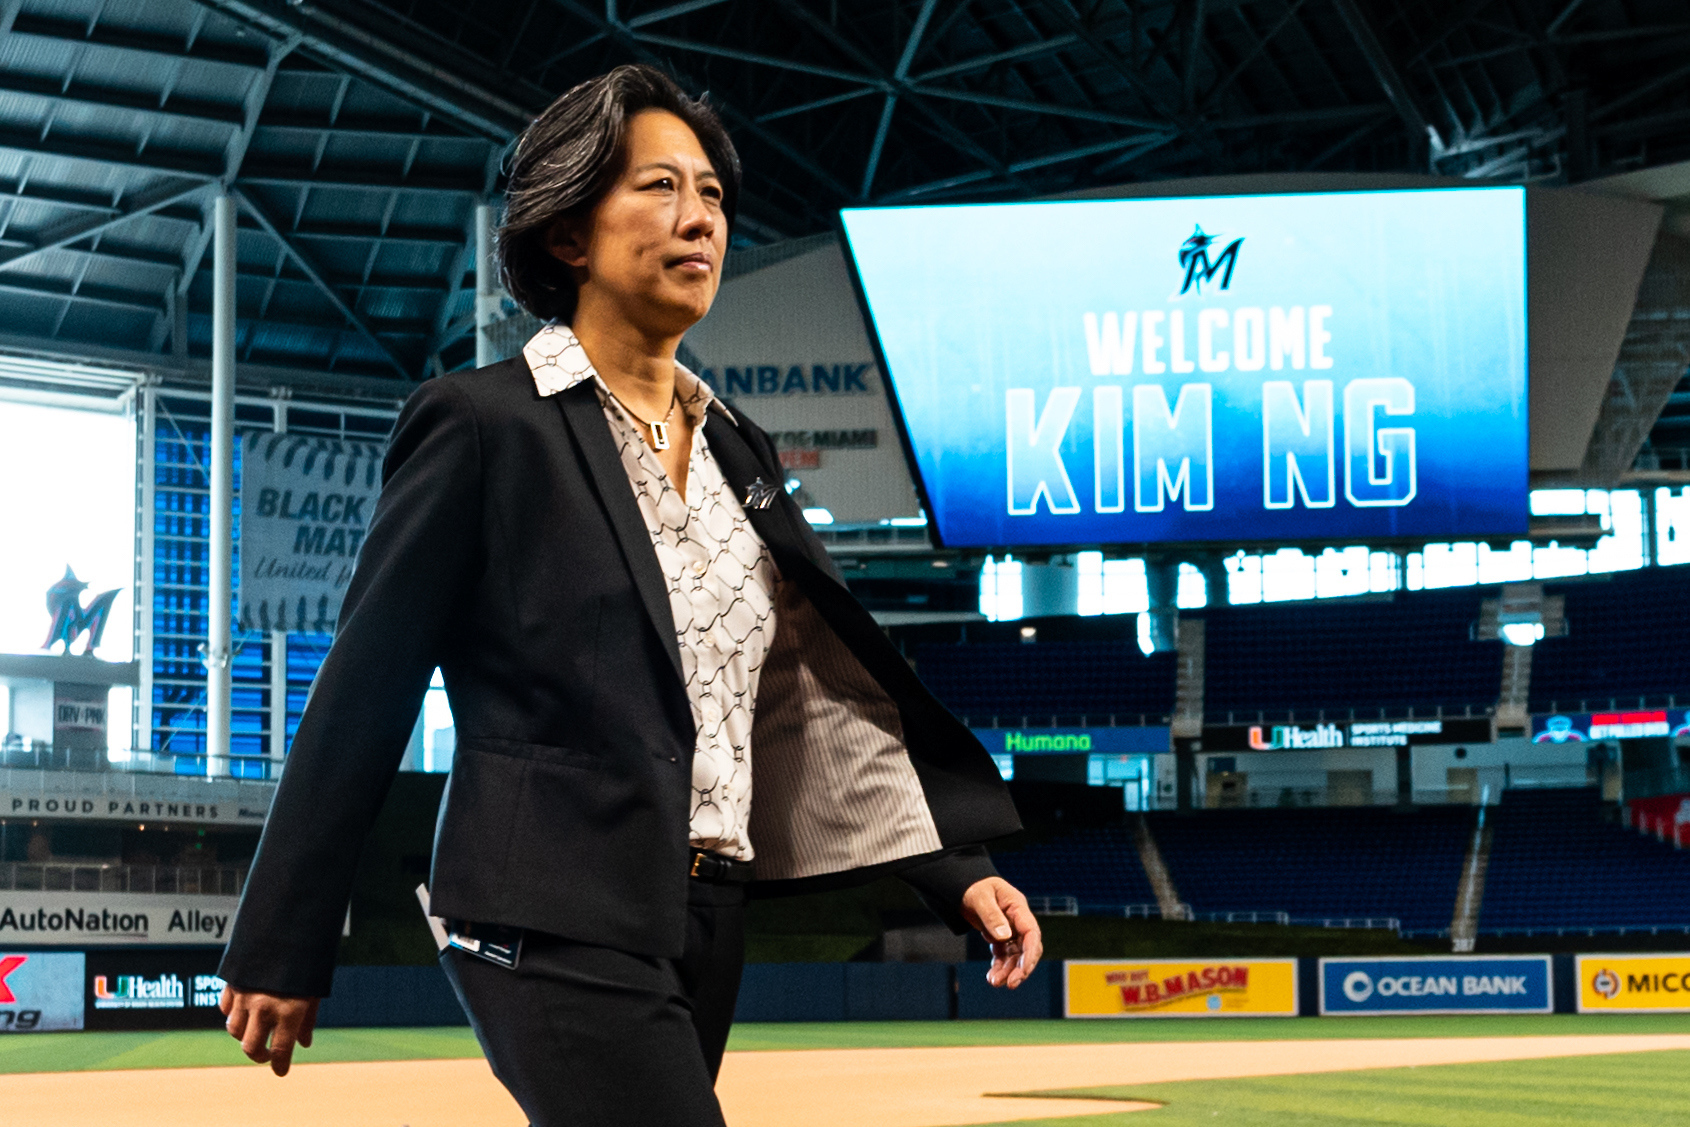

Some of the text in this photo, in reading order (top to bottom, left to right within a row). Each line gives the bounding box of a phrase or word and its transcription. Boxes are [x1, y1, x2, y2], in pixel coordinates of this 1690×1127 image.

[1083, 304, 1334, 376] WELCOME
[1005, 377, 1418, 515] KIM NG
[256, 487, 367, 524] BLACK
[293, 525, 366, 557] MAT
[253, 555, 333, 580] United
[1005, 731, 1091, 752] Humana
[12, 798, 94, 814] PROUD
[108, 801, 219, 819] PARTNERS
[0, 906, 229, 939] AutoNation Alley
[1377, 974, 1528, 997] OCEAN BANK
